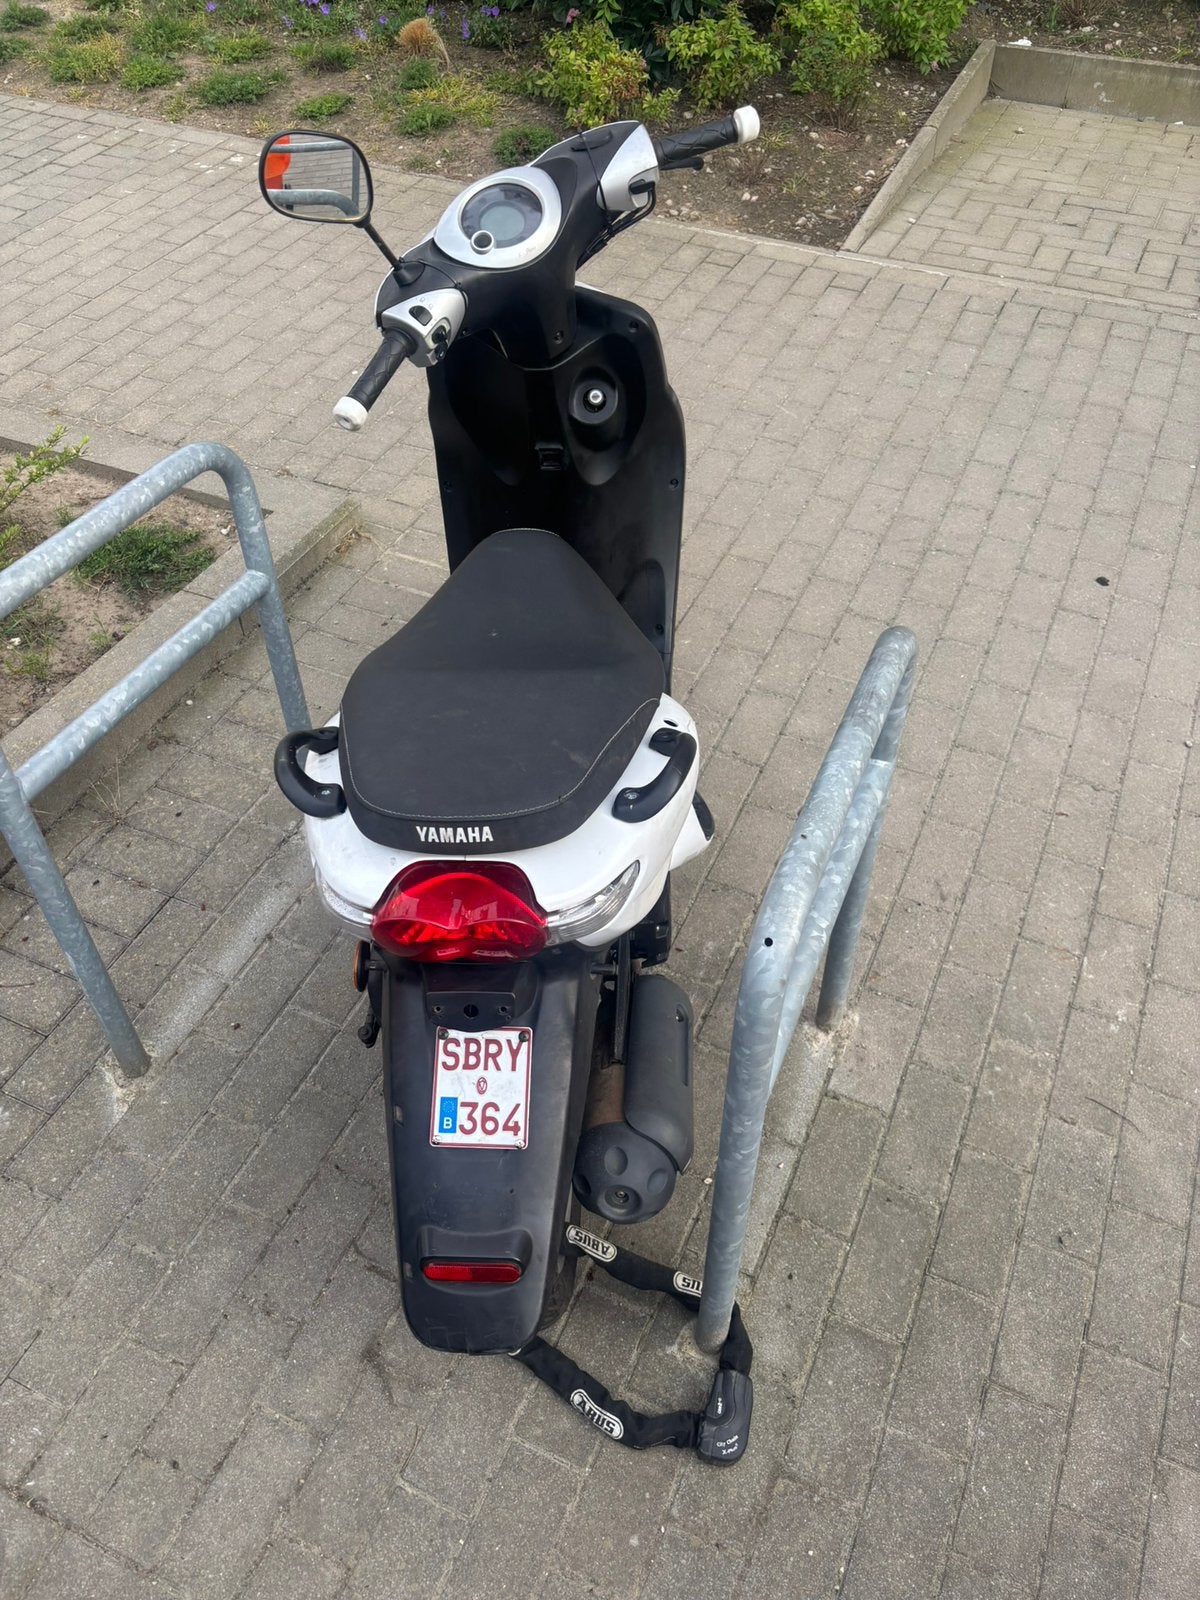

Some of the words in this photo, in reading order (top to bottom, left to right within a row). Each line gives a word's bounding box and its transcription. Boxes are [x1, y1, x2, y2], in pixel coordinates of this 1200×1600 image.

[415, 825, 494, 843] YAMAHA
[441, 1037, 524, 1072] SBRY
[443, 1117, 453, 1129] B
[458, 1101, 521, 1136] 364
[573, 1230, 611, 1256] ABUS
[681, 1276, 702, 1291] US
[576, 1394, 616, 1434] ABUS
